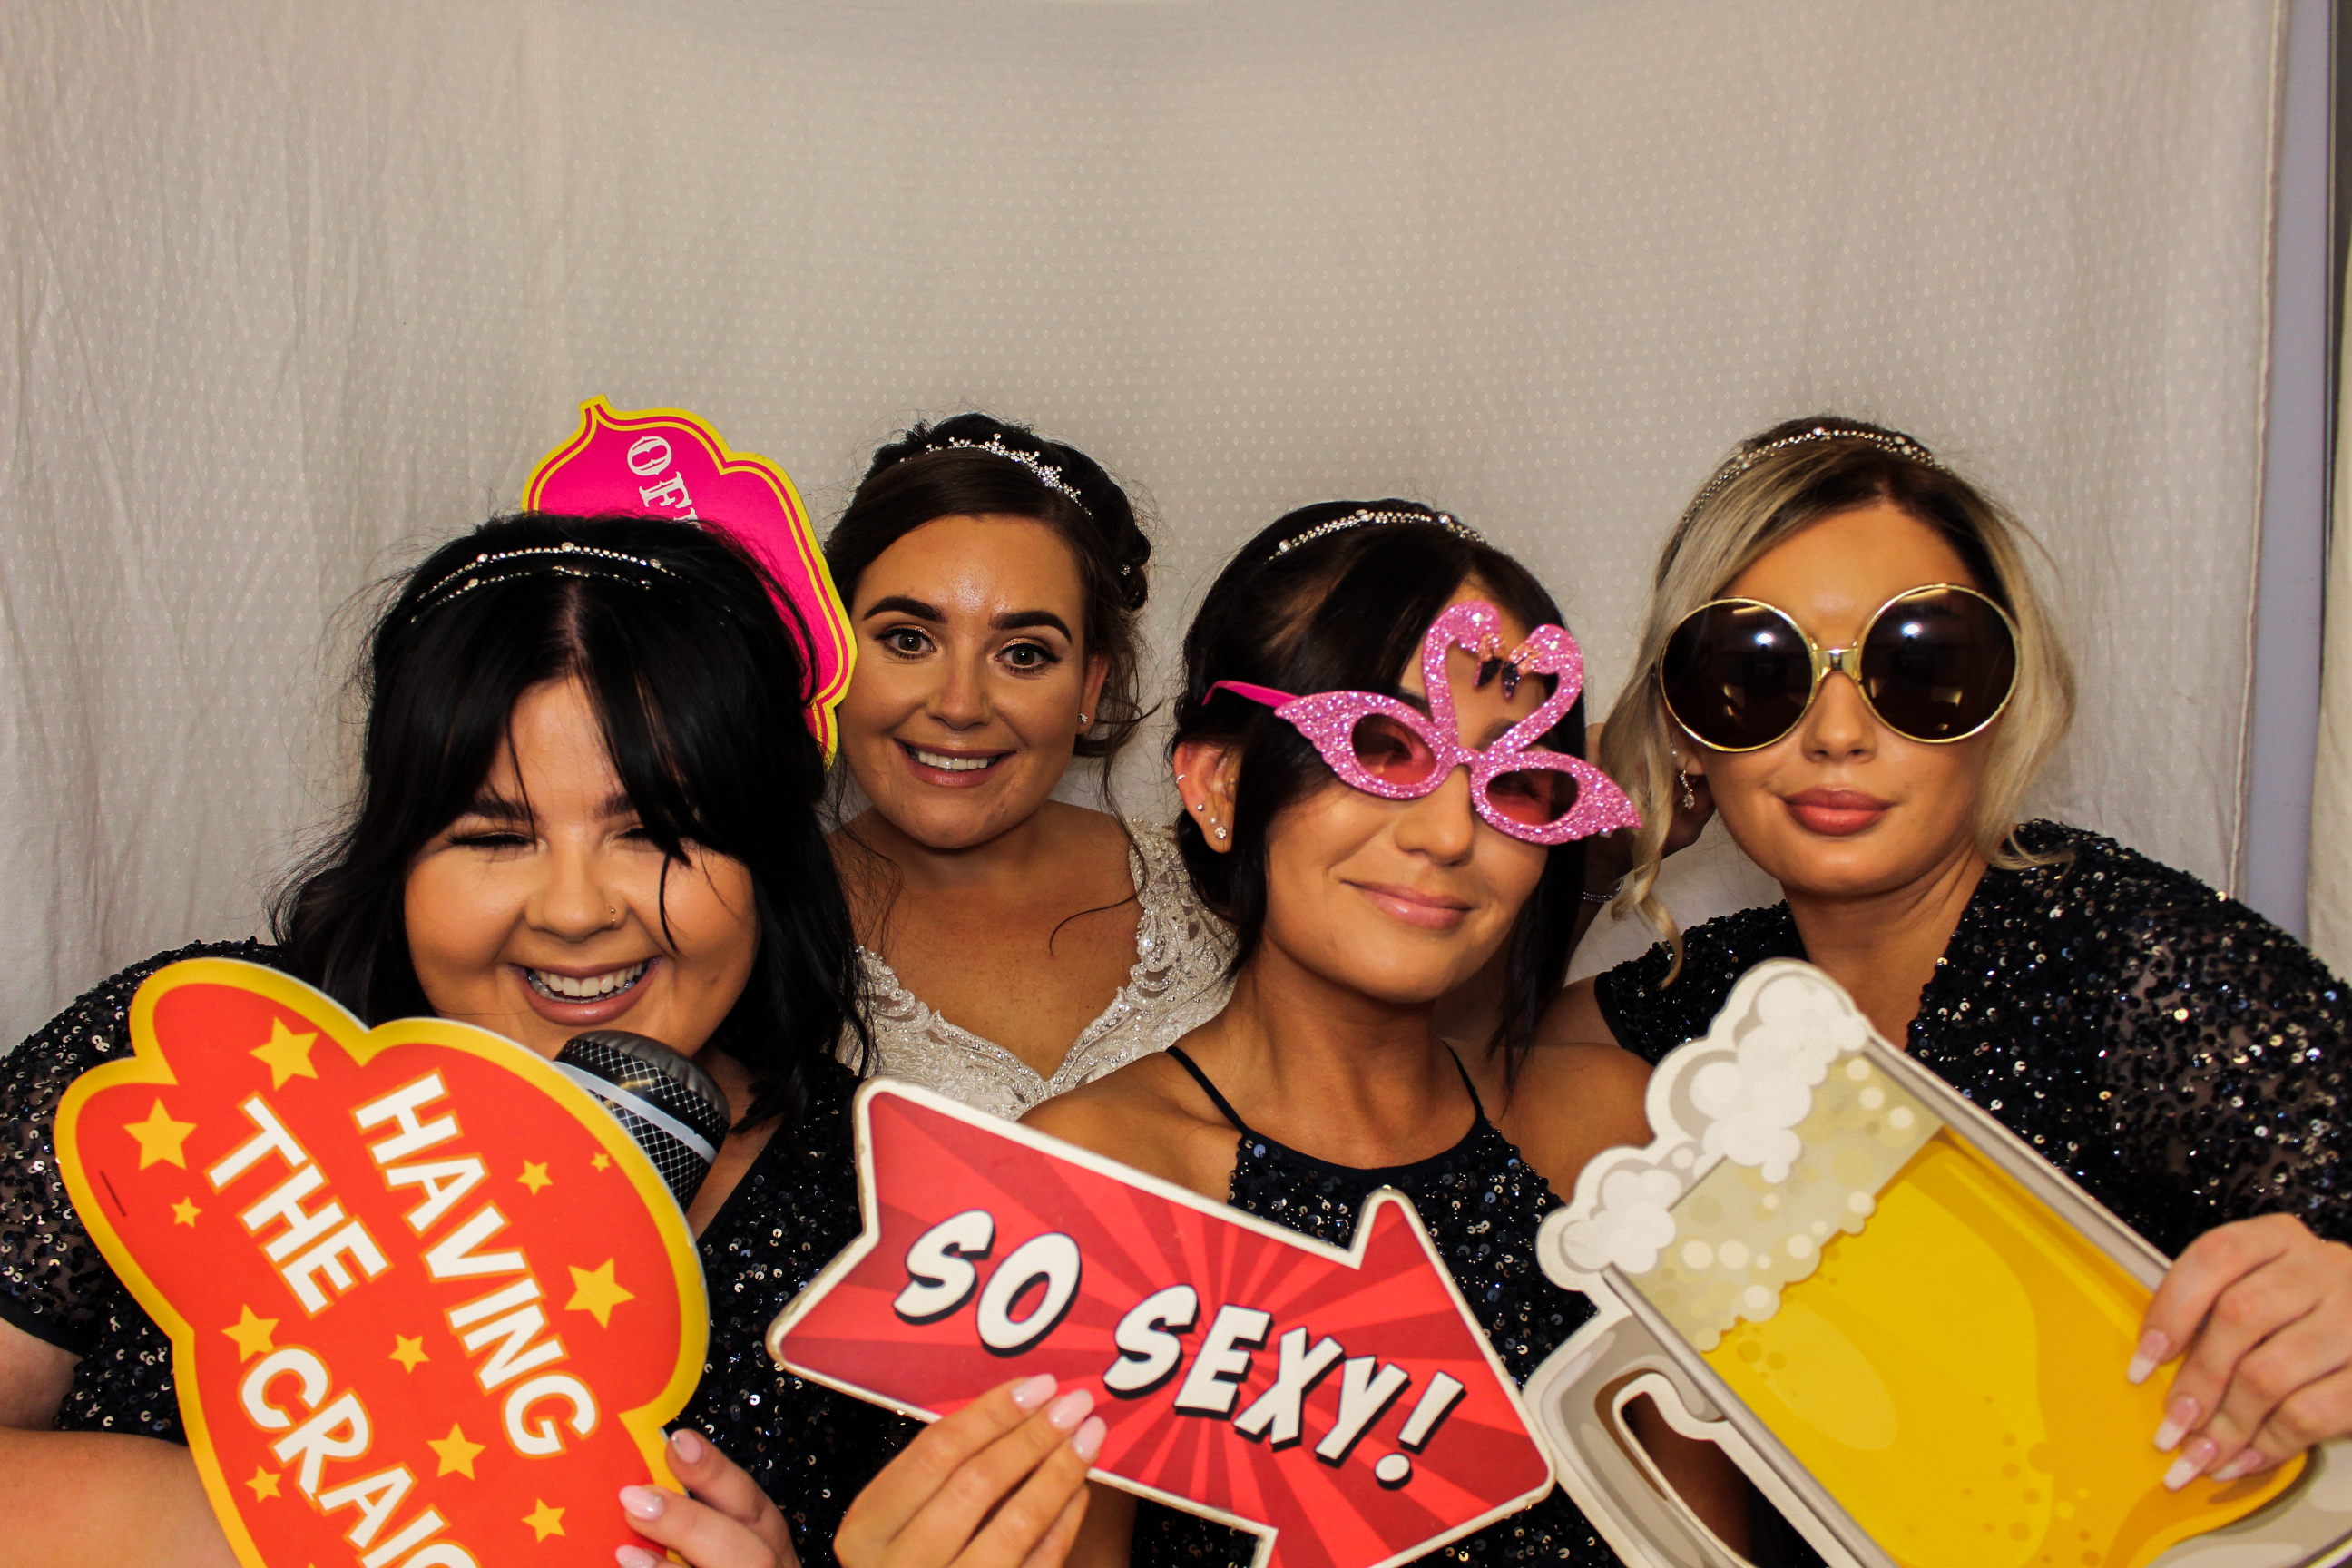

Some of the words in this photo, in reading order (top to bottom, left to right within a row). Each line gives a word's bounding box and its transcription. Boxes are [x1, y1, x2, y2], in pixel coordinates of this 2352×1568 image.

[626, 436, 701, 530] OF
[207, 1094, 392, 1315] THE
[354, 1073, 599, 1456] HAVING
[893, 1210, 1081, 1353] SO
[1102, 1285, 1465, 1487] SEXY!
